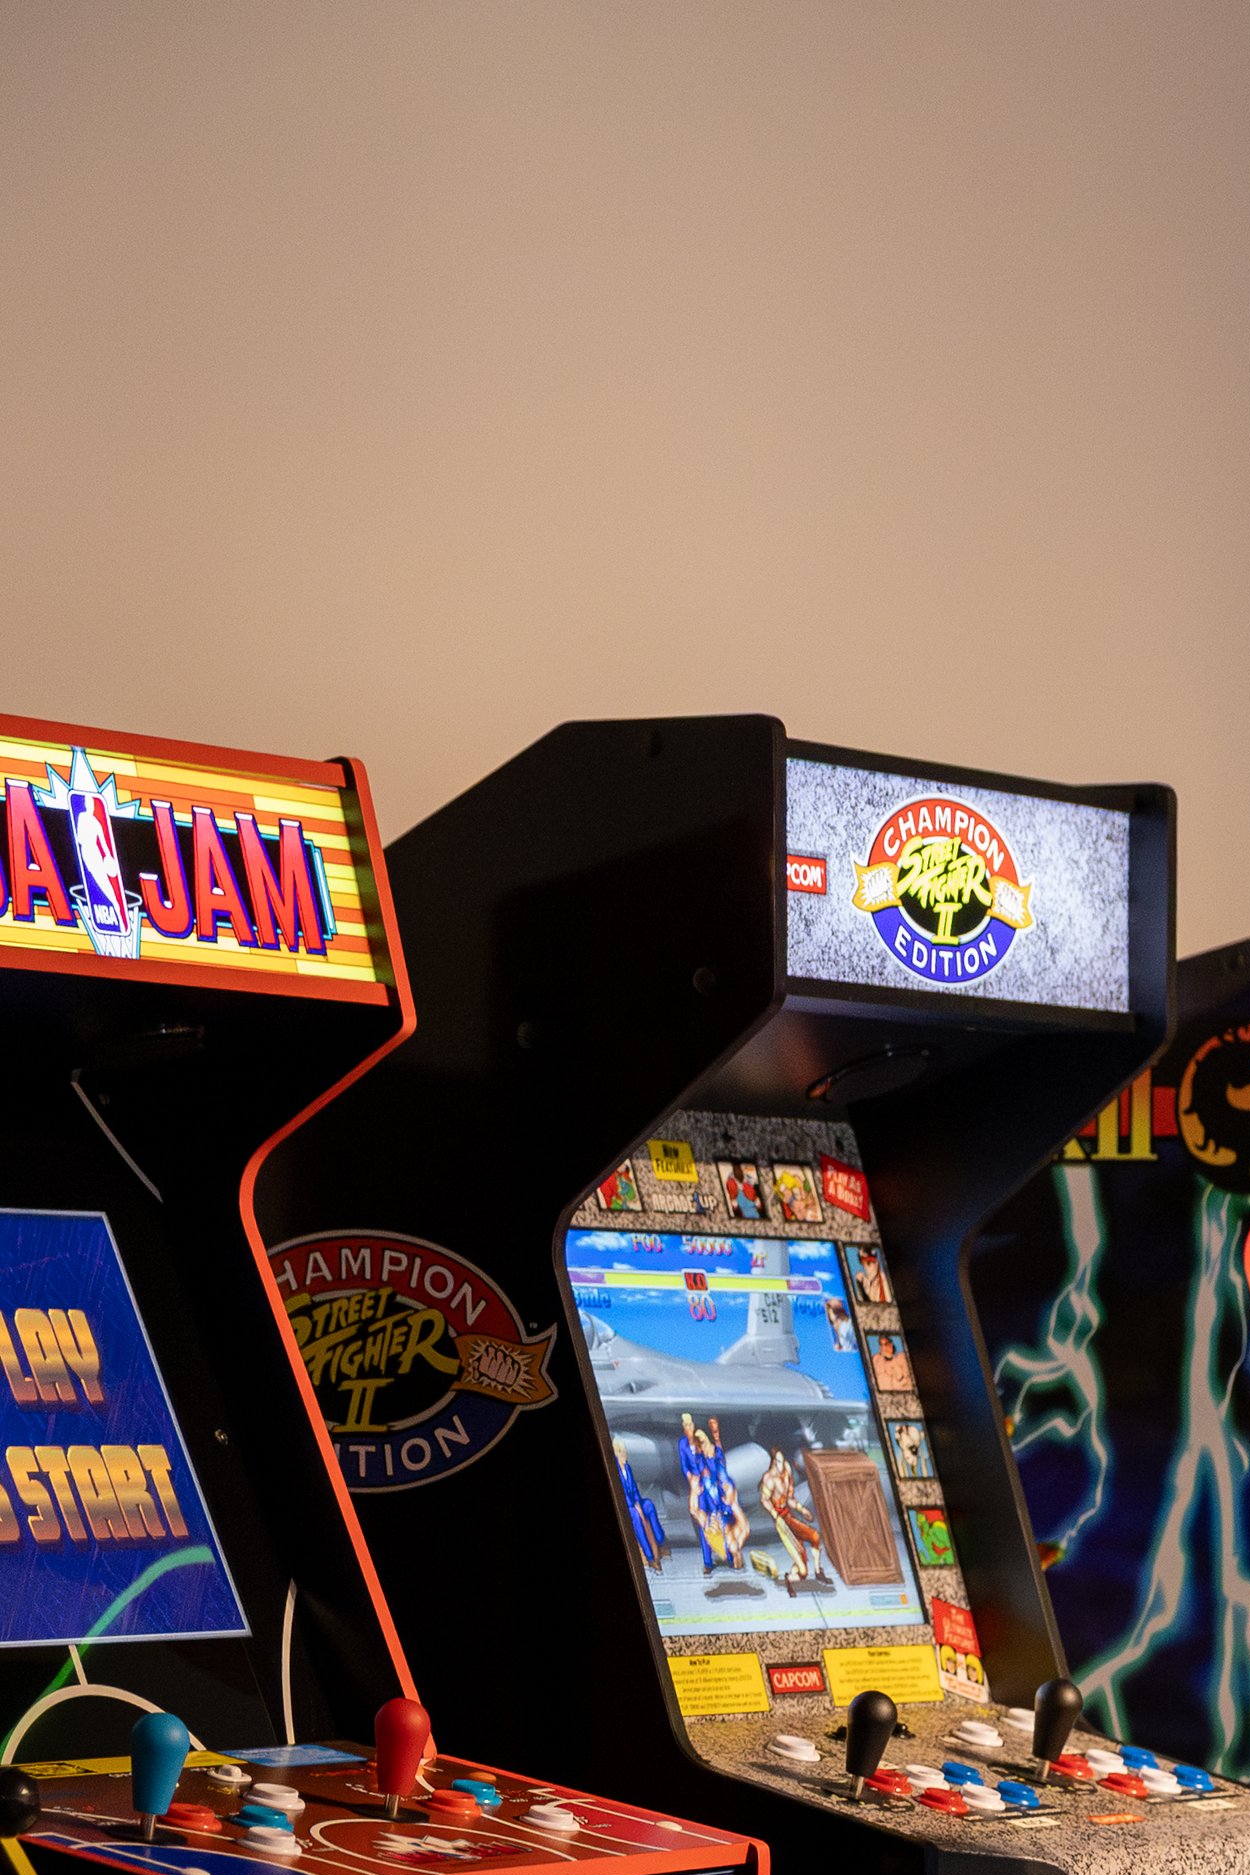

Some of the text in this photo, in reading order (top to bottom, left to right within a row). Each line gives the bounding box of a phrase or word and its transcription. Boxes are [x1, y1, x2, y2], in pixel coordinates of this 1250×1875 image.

[883, 806, 1004, 873] CHAMPION
[139, 800, 327, 955] JAM
[896, 836, 961, 898] STREET
[907, 854, 993, 909] FIGHTER
[93, 904, 119, 926] NBA
[931, 902, 963, 946] II
[894, 924, 998, 976] EDITION
[688, 1293, 717, 1321] 80
[302, 1308, 460, 1387] FIGHTER
[331, 1378, 394, 1432] II
[6, 1444, 189, 1542] START
[773, 1671, 821, 1688] CAPCOM
